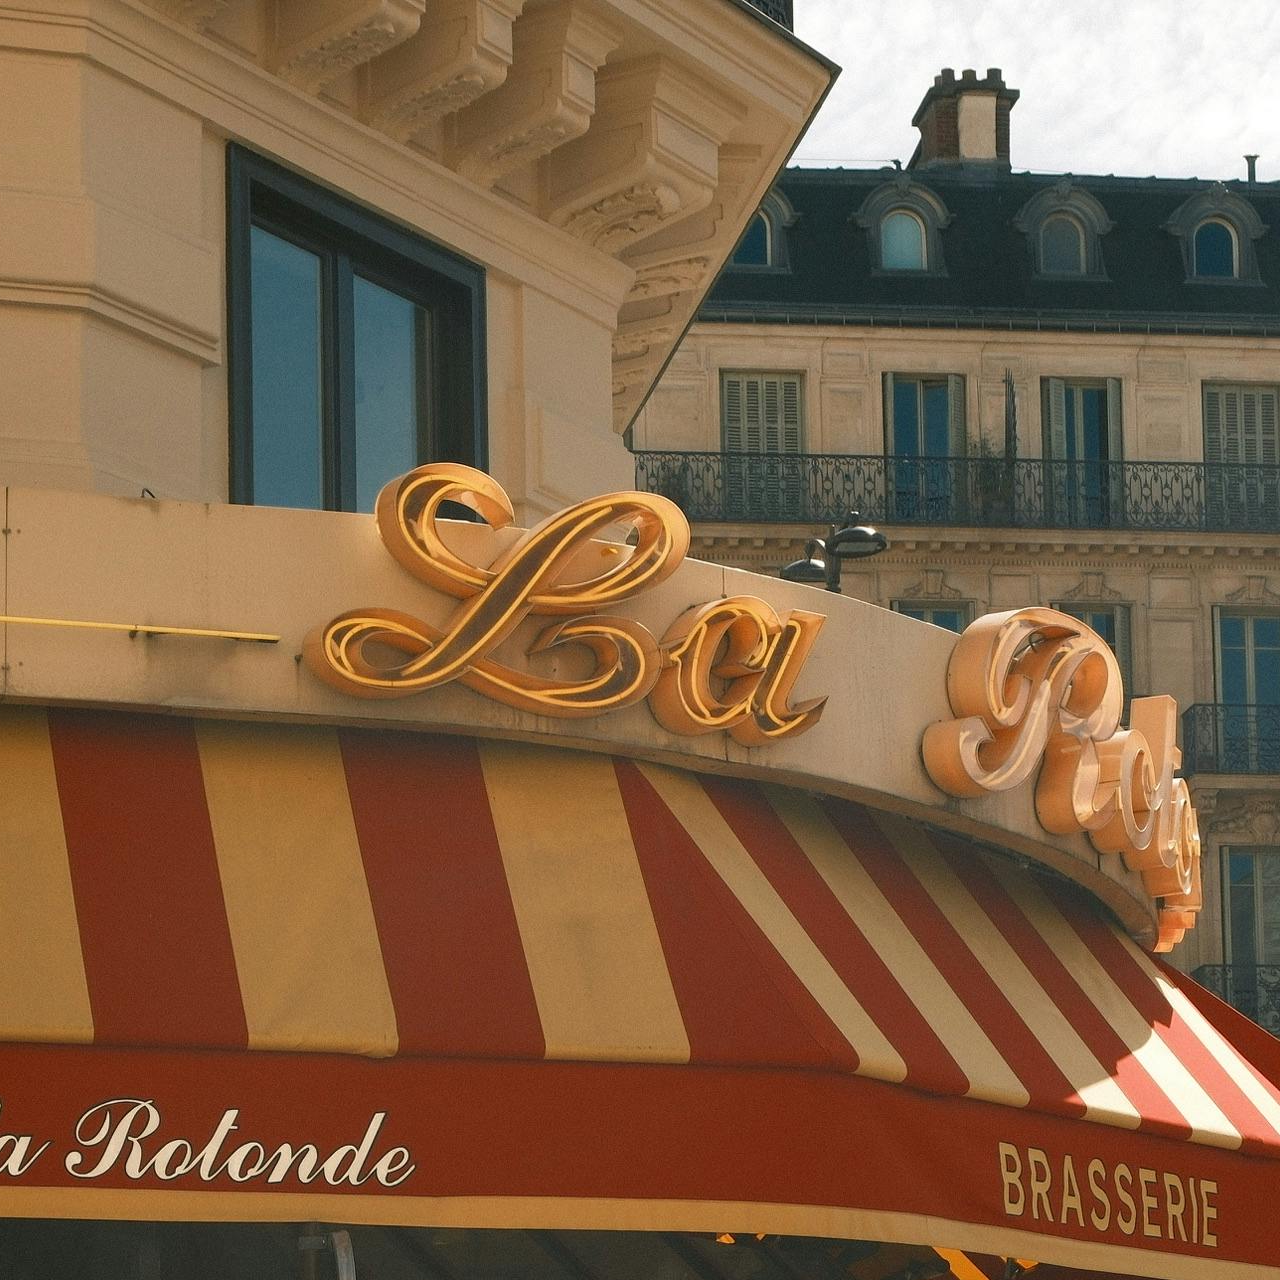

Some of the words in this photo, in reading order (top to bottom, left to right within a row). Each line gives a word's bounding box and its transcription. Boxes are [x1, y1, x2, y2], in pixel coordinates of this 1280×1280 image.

[303, 462, 829, 747] La
[65, 1098, 416, 1187] Rotonde
[999, 1142, 1218, 1247] BRASSERIE
